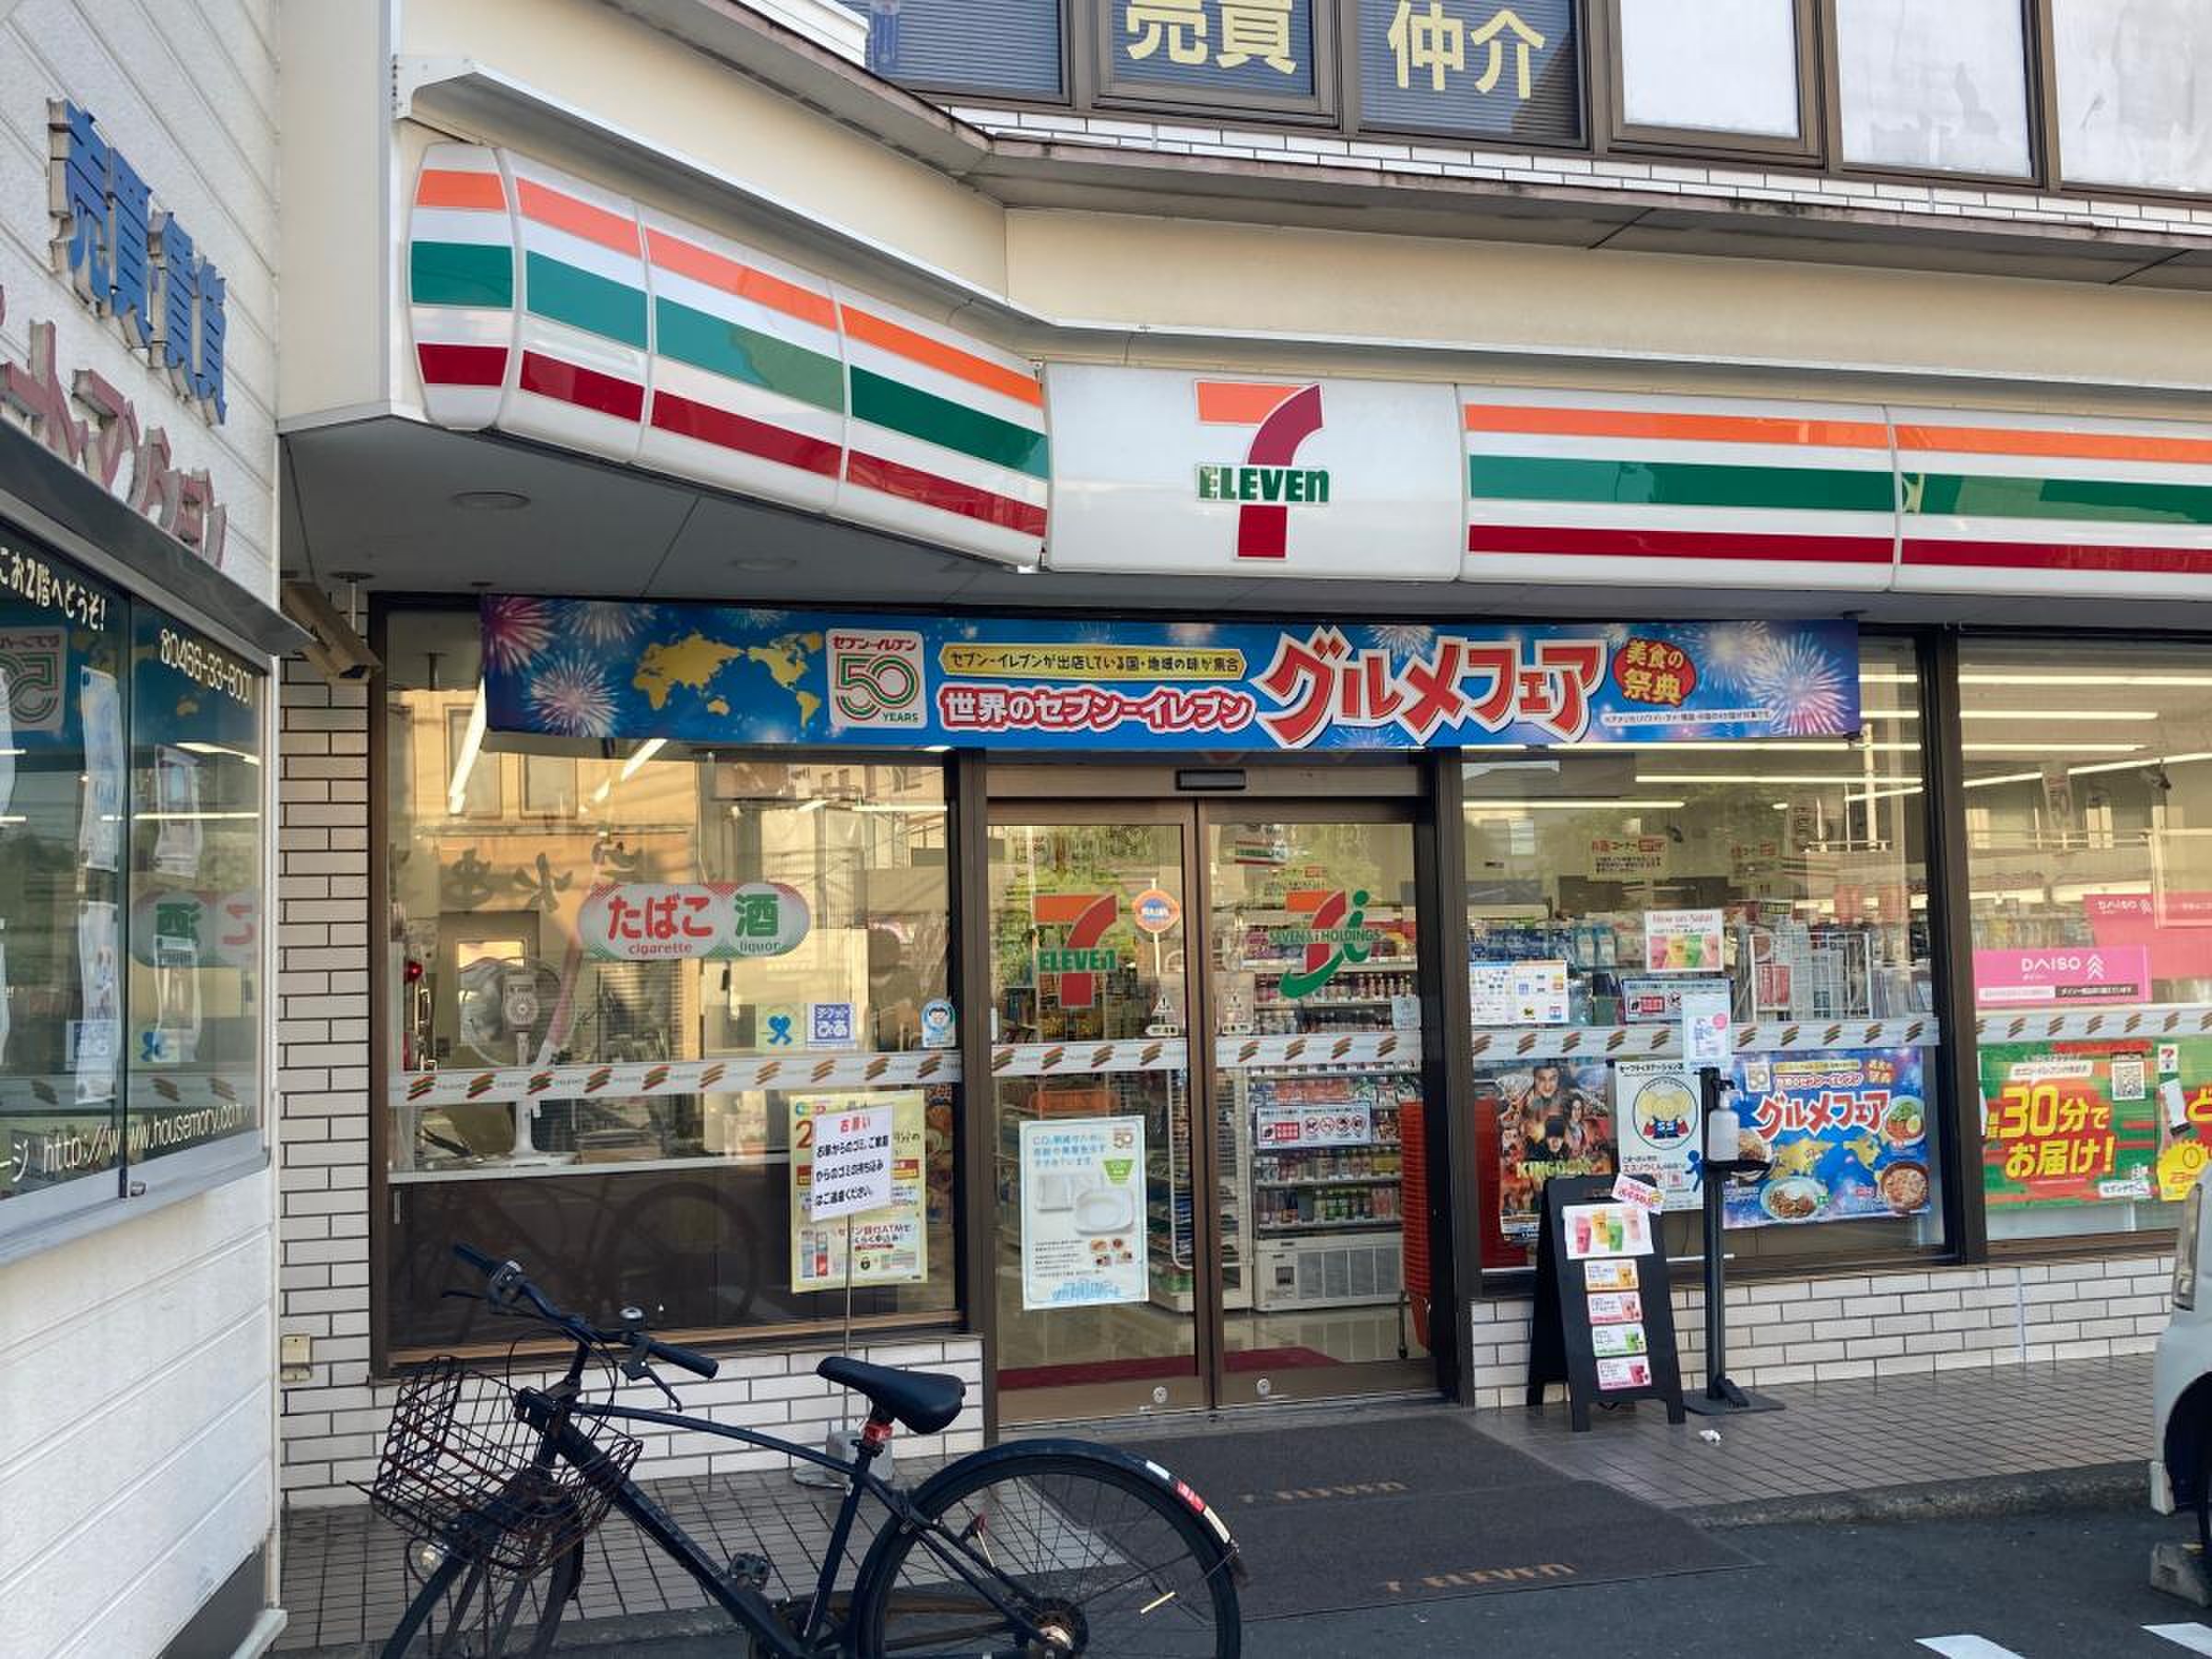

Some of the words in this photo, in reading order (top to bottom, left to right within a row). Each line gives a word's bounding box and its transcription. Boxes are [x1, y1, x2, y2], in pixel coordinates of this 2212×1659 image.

[1387, 2, 1545, 99] 仲介
[1626, 640, 1684, 669] 美食の
[836, 653, 920, 721] 50
[1257, 630, 1606, 747] グルメフェア
[1624, 668, 1683, 703] 祭典
[883, 712, 919, 723] YEARS
[607, 891, 714, 941] たばこ
[735, 893, 779, 937] 酒
[629, 942, 693, 957] cigarette
[740, 941, 780, 954] liquor
[2021, 957, 2081, 971] DAISO
[1754, 1091, 1890, 1142] グルメフェア
[2000, 1084, 2110, 1139] 30分で
[2005, 1135, 2114, 1178] お届け!
